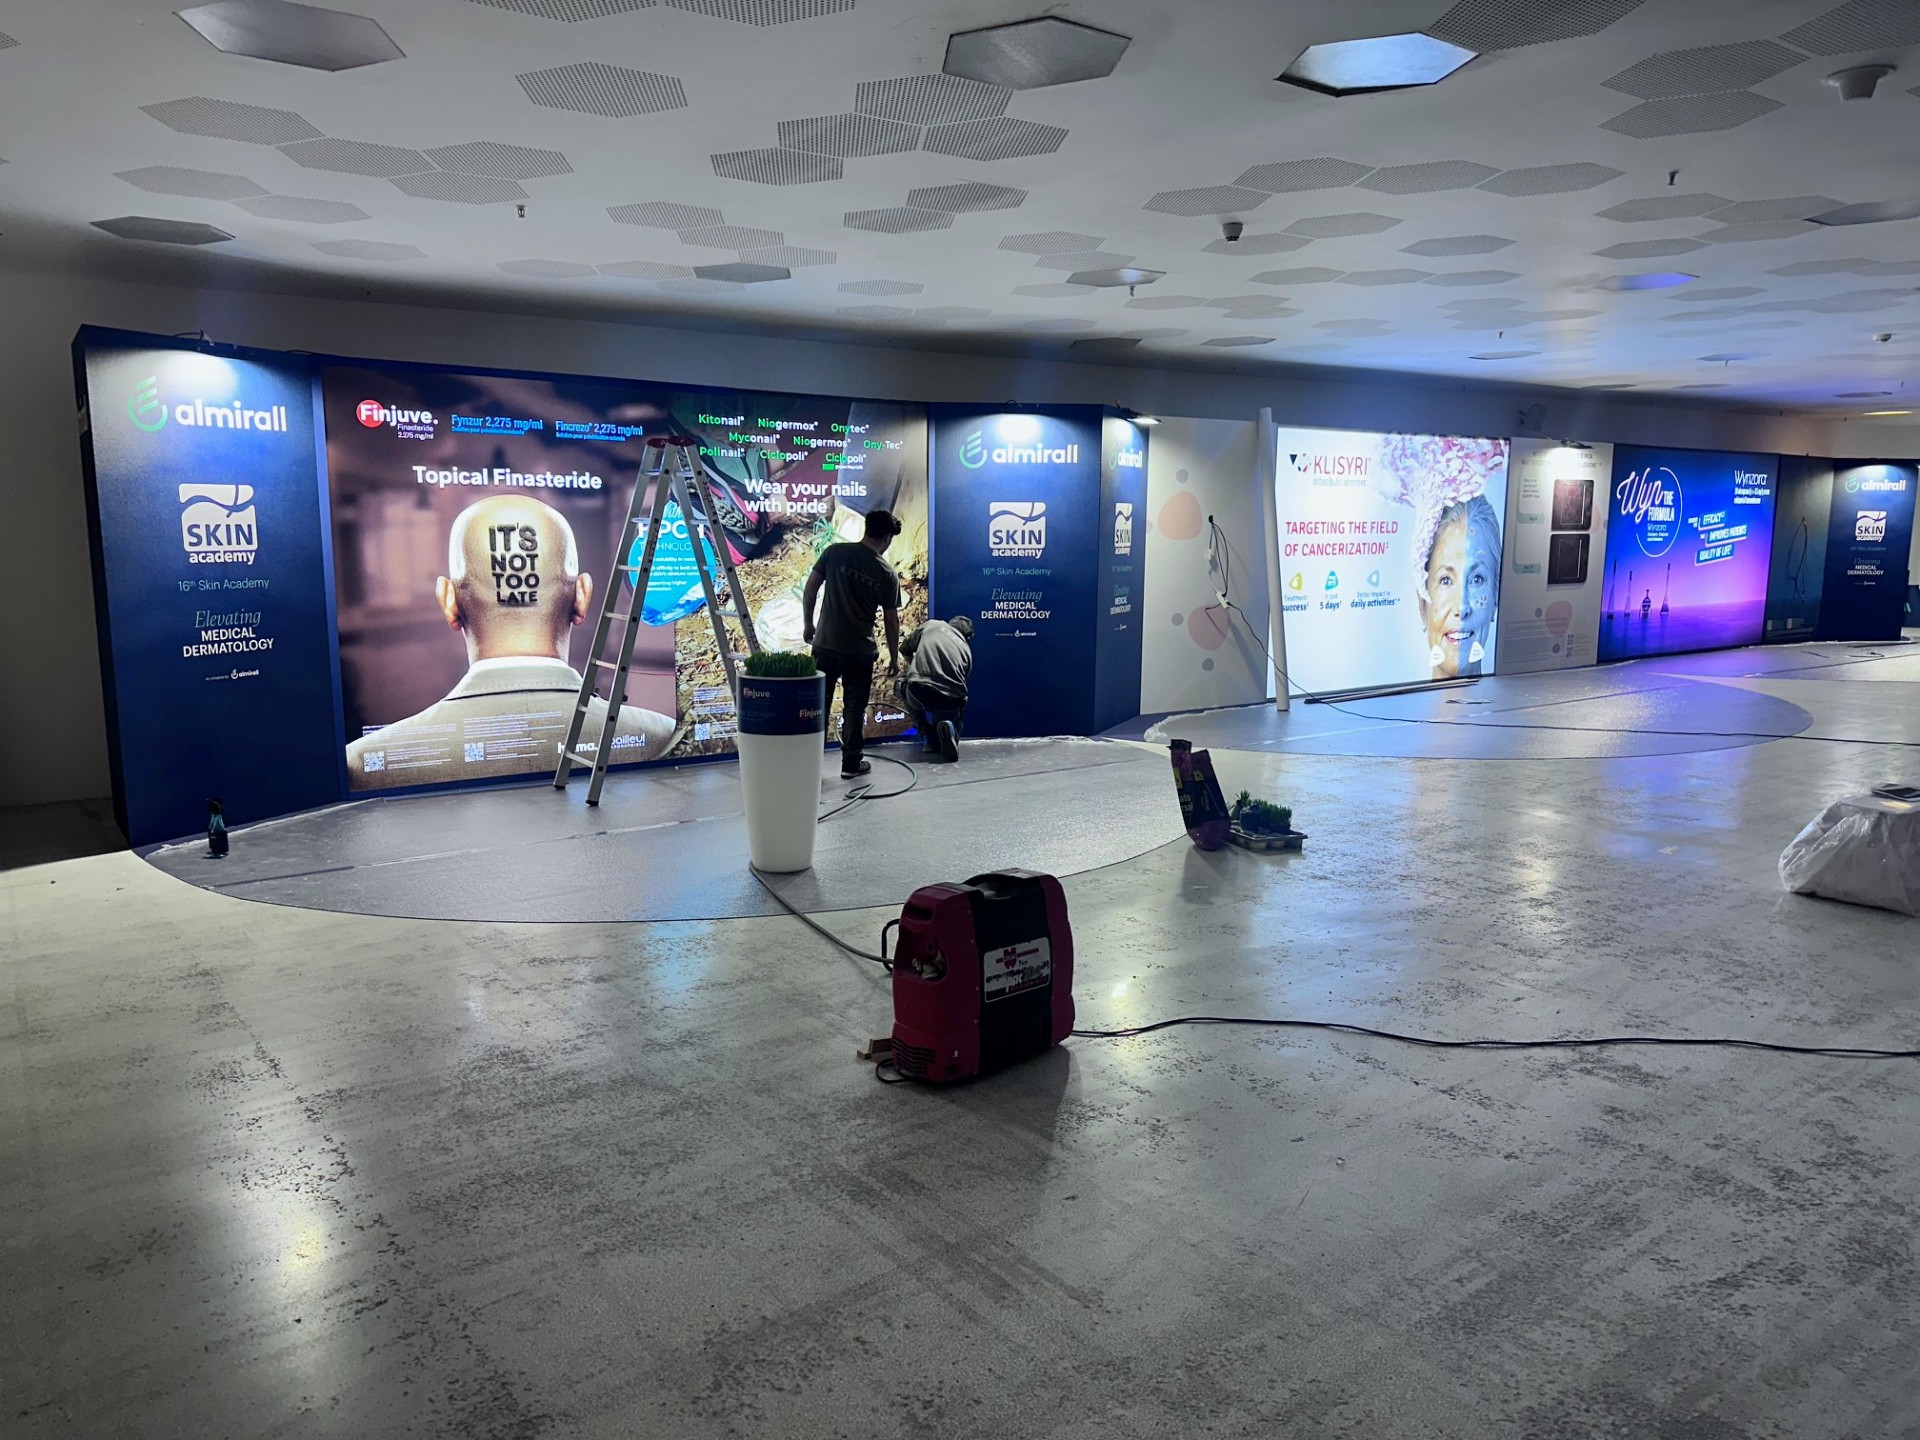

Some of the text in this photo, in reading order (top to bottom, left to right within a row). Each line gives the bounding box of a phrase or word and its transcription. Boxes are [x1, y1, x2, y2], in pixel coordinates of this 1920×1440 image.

[175, 400, 287, 432] almirall
[451, 414, 543, 431] Fynzur 2,275 mg/ml
[397, 424, 434, 432] Finasteride
[594, 423, 617, 435] 2,275
[618, 425, 643, 437] mg/ml
[992, 443, 1079, 464] almirall
[1117, 450, 1143, 468] almirall
[412, 466, 603, 490] Topical Finasteride
[1734, 470, 1768, 487] Wynzora
[1861, 479, 1906, 491] almirall
[744, 478, 867, 499] Wear your nails
[1617, 467, 1664, 525] Wyn
[1663, 491, 1674, 505] THE
[744, 497, 828, 516] with pride
[1647, 507, 1675, 521] FORMULA
[188, 523, 253, 547] SKIN
[1286, 521, 1399, 535] TARGETING THE FIELD
[1857, 525, 1884, 534] SKIN
[488, 522, 538, 552] IT'S
[992, 529, 1043, 546] SKIN
[1115, 528, 1131, 544] SKIN
[189, 550, 255, 565] academy
[992, 548, 1043, 559] academy
[1284, 544, 1299, 557] OF
[1699, 548, 1716, 561] QUALITY
[1716, 547, 1722, 557] OF
[490, 553, 539, 572] NOT
[997, 567, 1013, 575] Skin
[1015, 567, 1051, 577] Academy
[198, 579, 220, 591] Skin
[223, 578, 270, 589] Academy
[492, 572, 540, 589] TOO
[496, 591, 538, 604] LATE
[991, 588, 1043, 602] Elevating
[995, 601, 1037, 610] MEDICAL
[1319, 602, 1324, 610] 5
[1350, 599, 1367, 610] daily
[194, 608, 261, 628] Elevating
[981, 610, 1051, 619] DERMATOLOGY
[201, 626, 256, 642] MEDICAL
[183, 638, 274, 658] DERMATOLOGY
